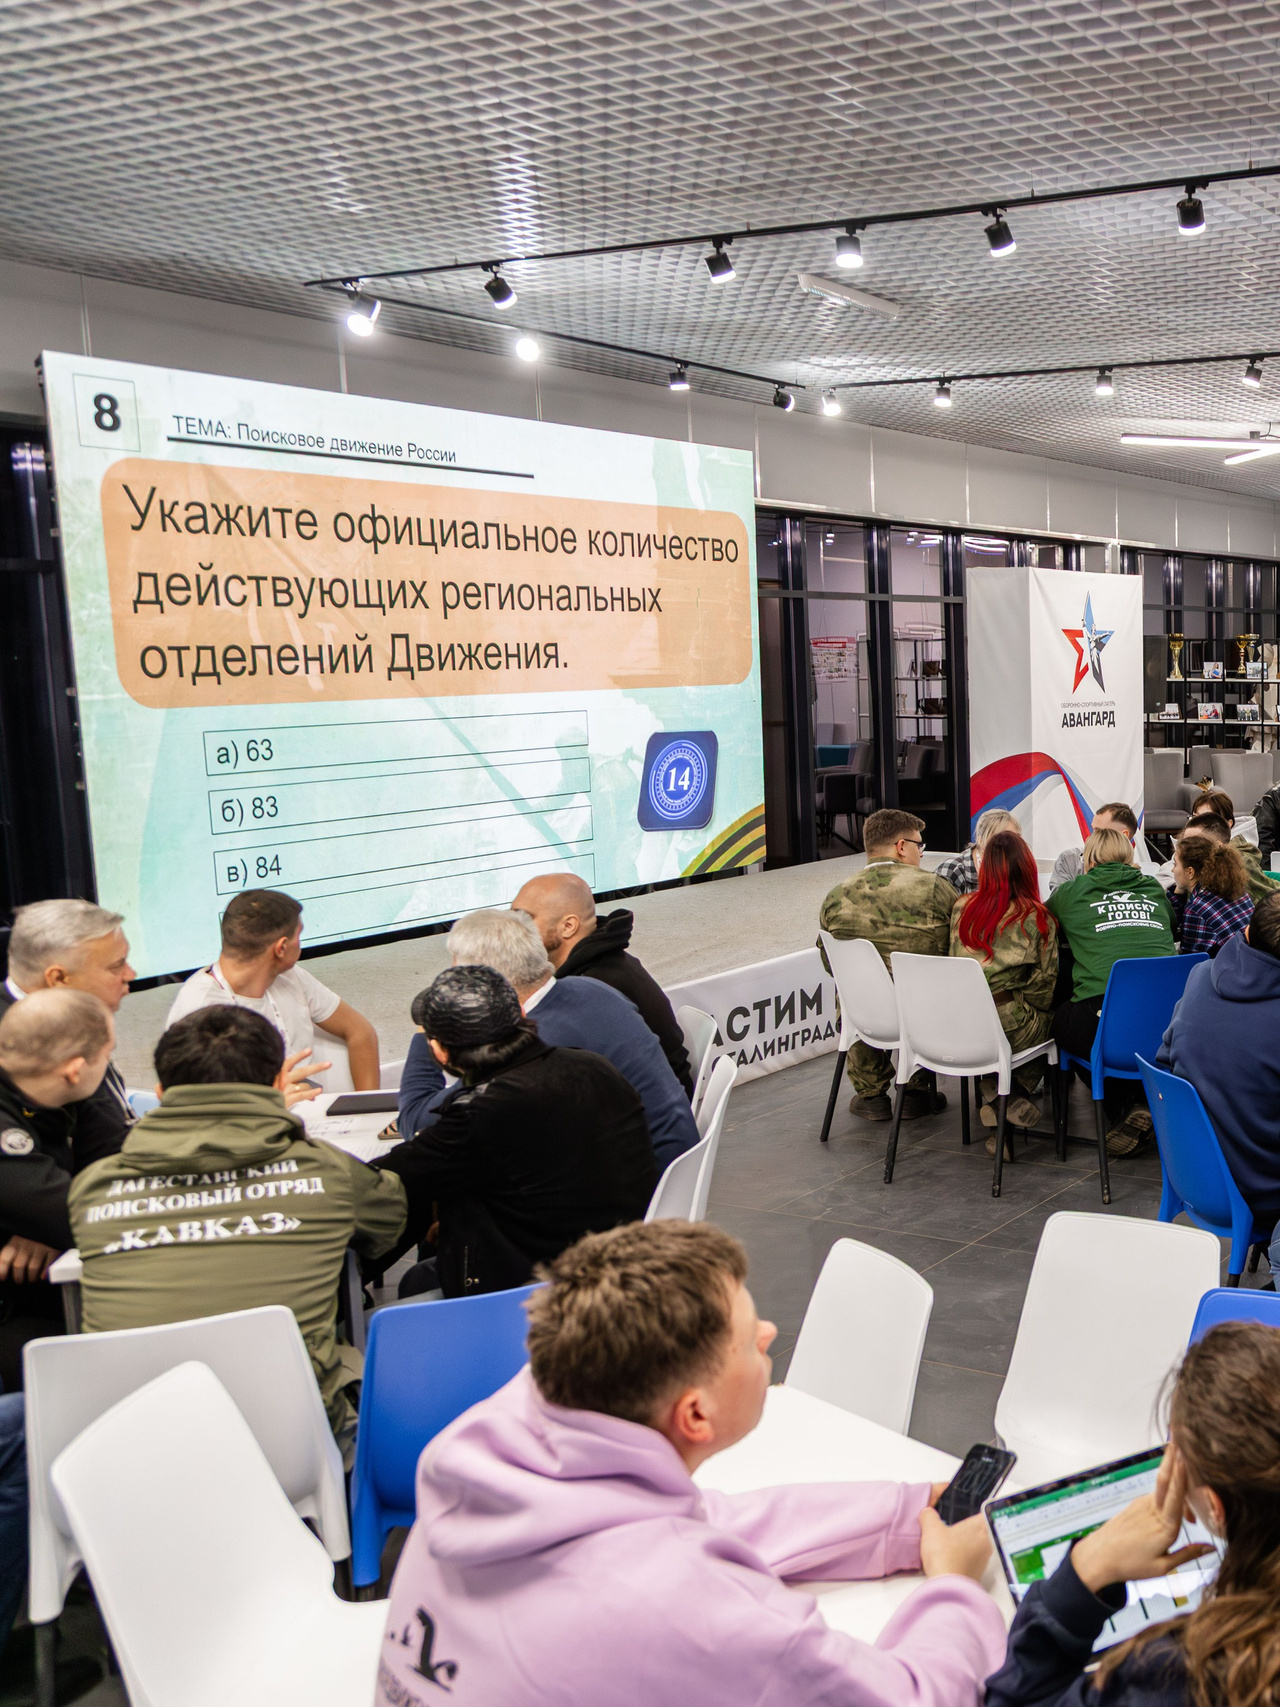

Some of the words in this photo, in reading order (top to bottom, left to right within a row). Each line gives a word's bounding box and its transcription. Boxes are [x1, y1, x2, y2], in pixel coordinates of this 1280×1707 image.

[93, 393, 121, 432] 8
[172, 415, 231, 439] ТЕМА:
[237, 423, 325, 449] Поисковое
[330, 436, 403, 458] движение
[407, 443, 457, 463] России
[122, 484, 318, 541] Укажите
[333, 503, 578, 554] официальное
[588, 529, 739, 563] количество
[132, 562, 429, 619] действующих
[441, 580, 663, 619] региональных
[140, 633, 374, 686] отделений
[387, 633, 569, 680] Движения.
[1061, 710, 1116, 728] АВАНГАРД
[216, 740, 238, 769] а)
[246, 739, 274, 762] 63
[666, 766, 690, 792] 14
[221, 798, 244, 827] б)
[251, 796, 279, 819] 83
[227, 859, 247, 886] в)
[255, 854, 282, 879] 84
[1097, 905, 1107, 915] К
[1108, 903, 1155, 913] ПОИСКУ
[106, 1159, 299, 1198] ДАГЕСТАНСКИЙ
[85, 1182, 242, 1224] ПОИСКОВЫЙ
[245, 1177, 325, 1201] ОТРЯД
[103, 1212, 302, 1254] «КАВКАЗ»
